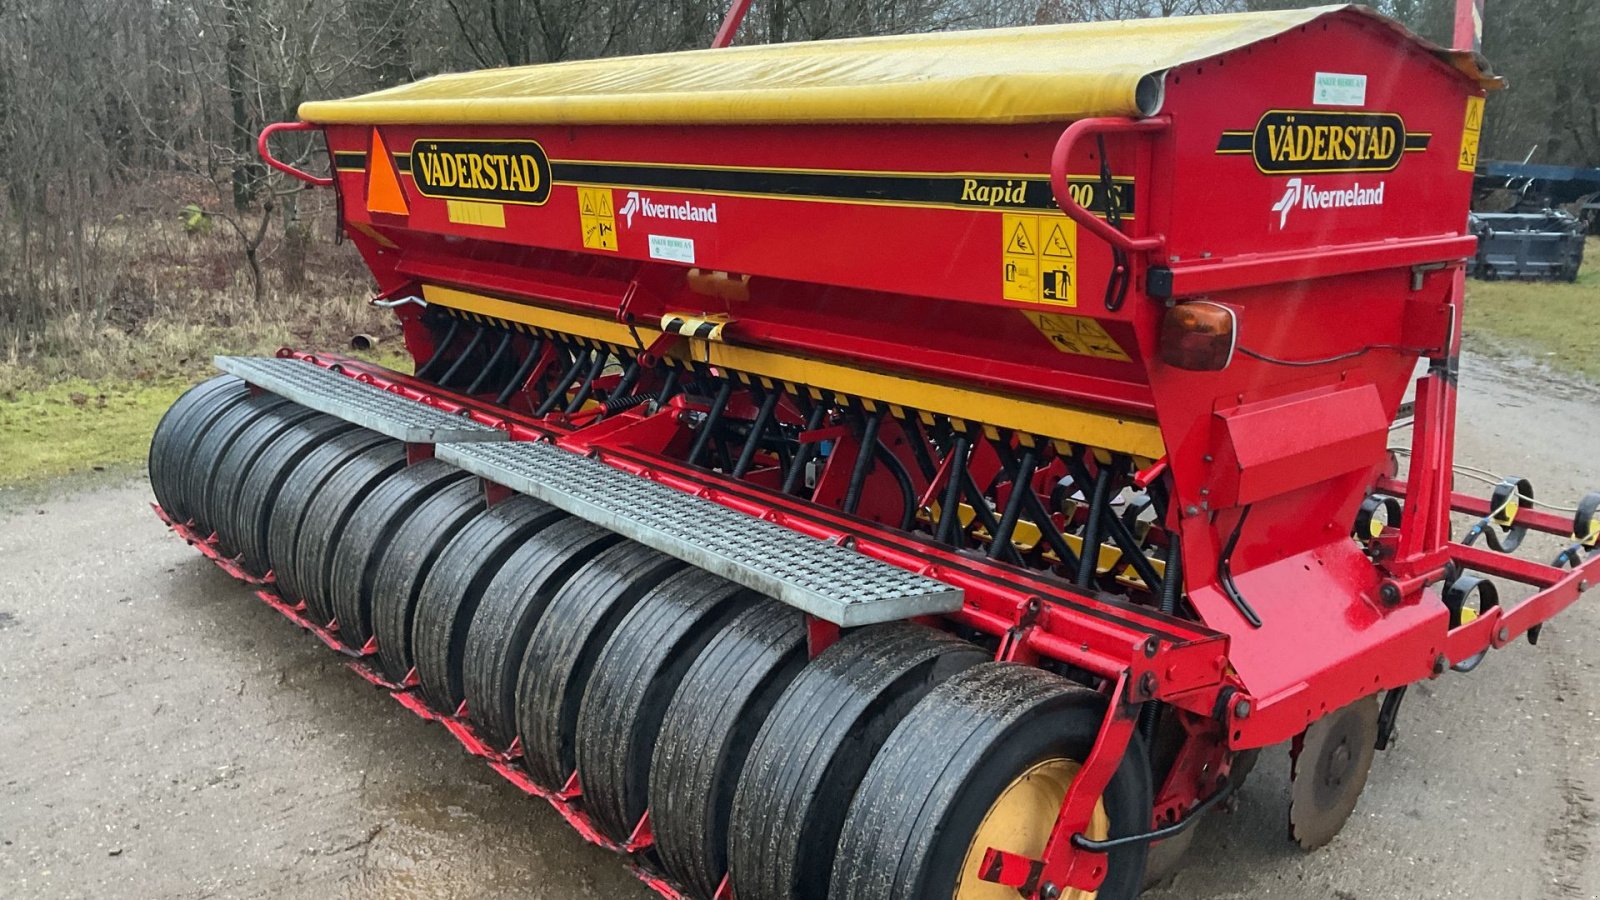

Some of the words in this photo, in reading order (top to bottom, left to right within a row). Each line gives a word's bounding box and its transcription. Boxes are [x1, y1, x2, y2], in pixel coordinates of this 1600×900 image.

[1267, 116, 1396, 162] VÄDERSTAD
[418, 144, 540, 192] VÄDERSTAD
[961, 179, 1028, 206] Rapid
[1052, 183, 1094, 208] 00
[1302, 181, 1385, 209] Kverneland
[641, 197, 717, 223] Kverneland
